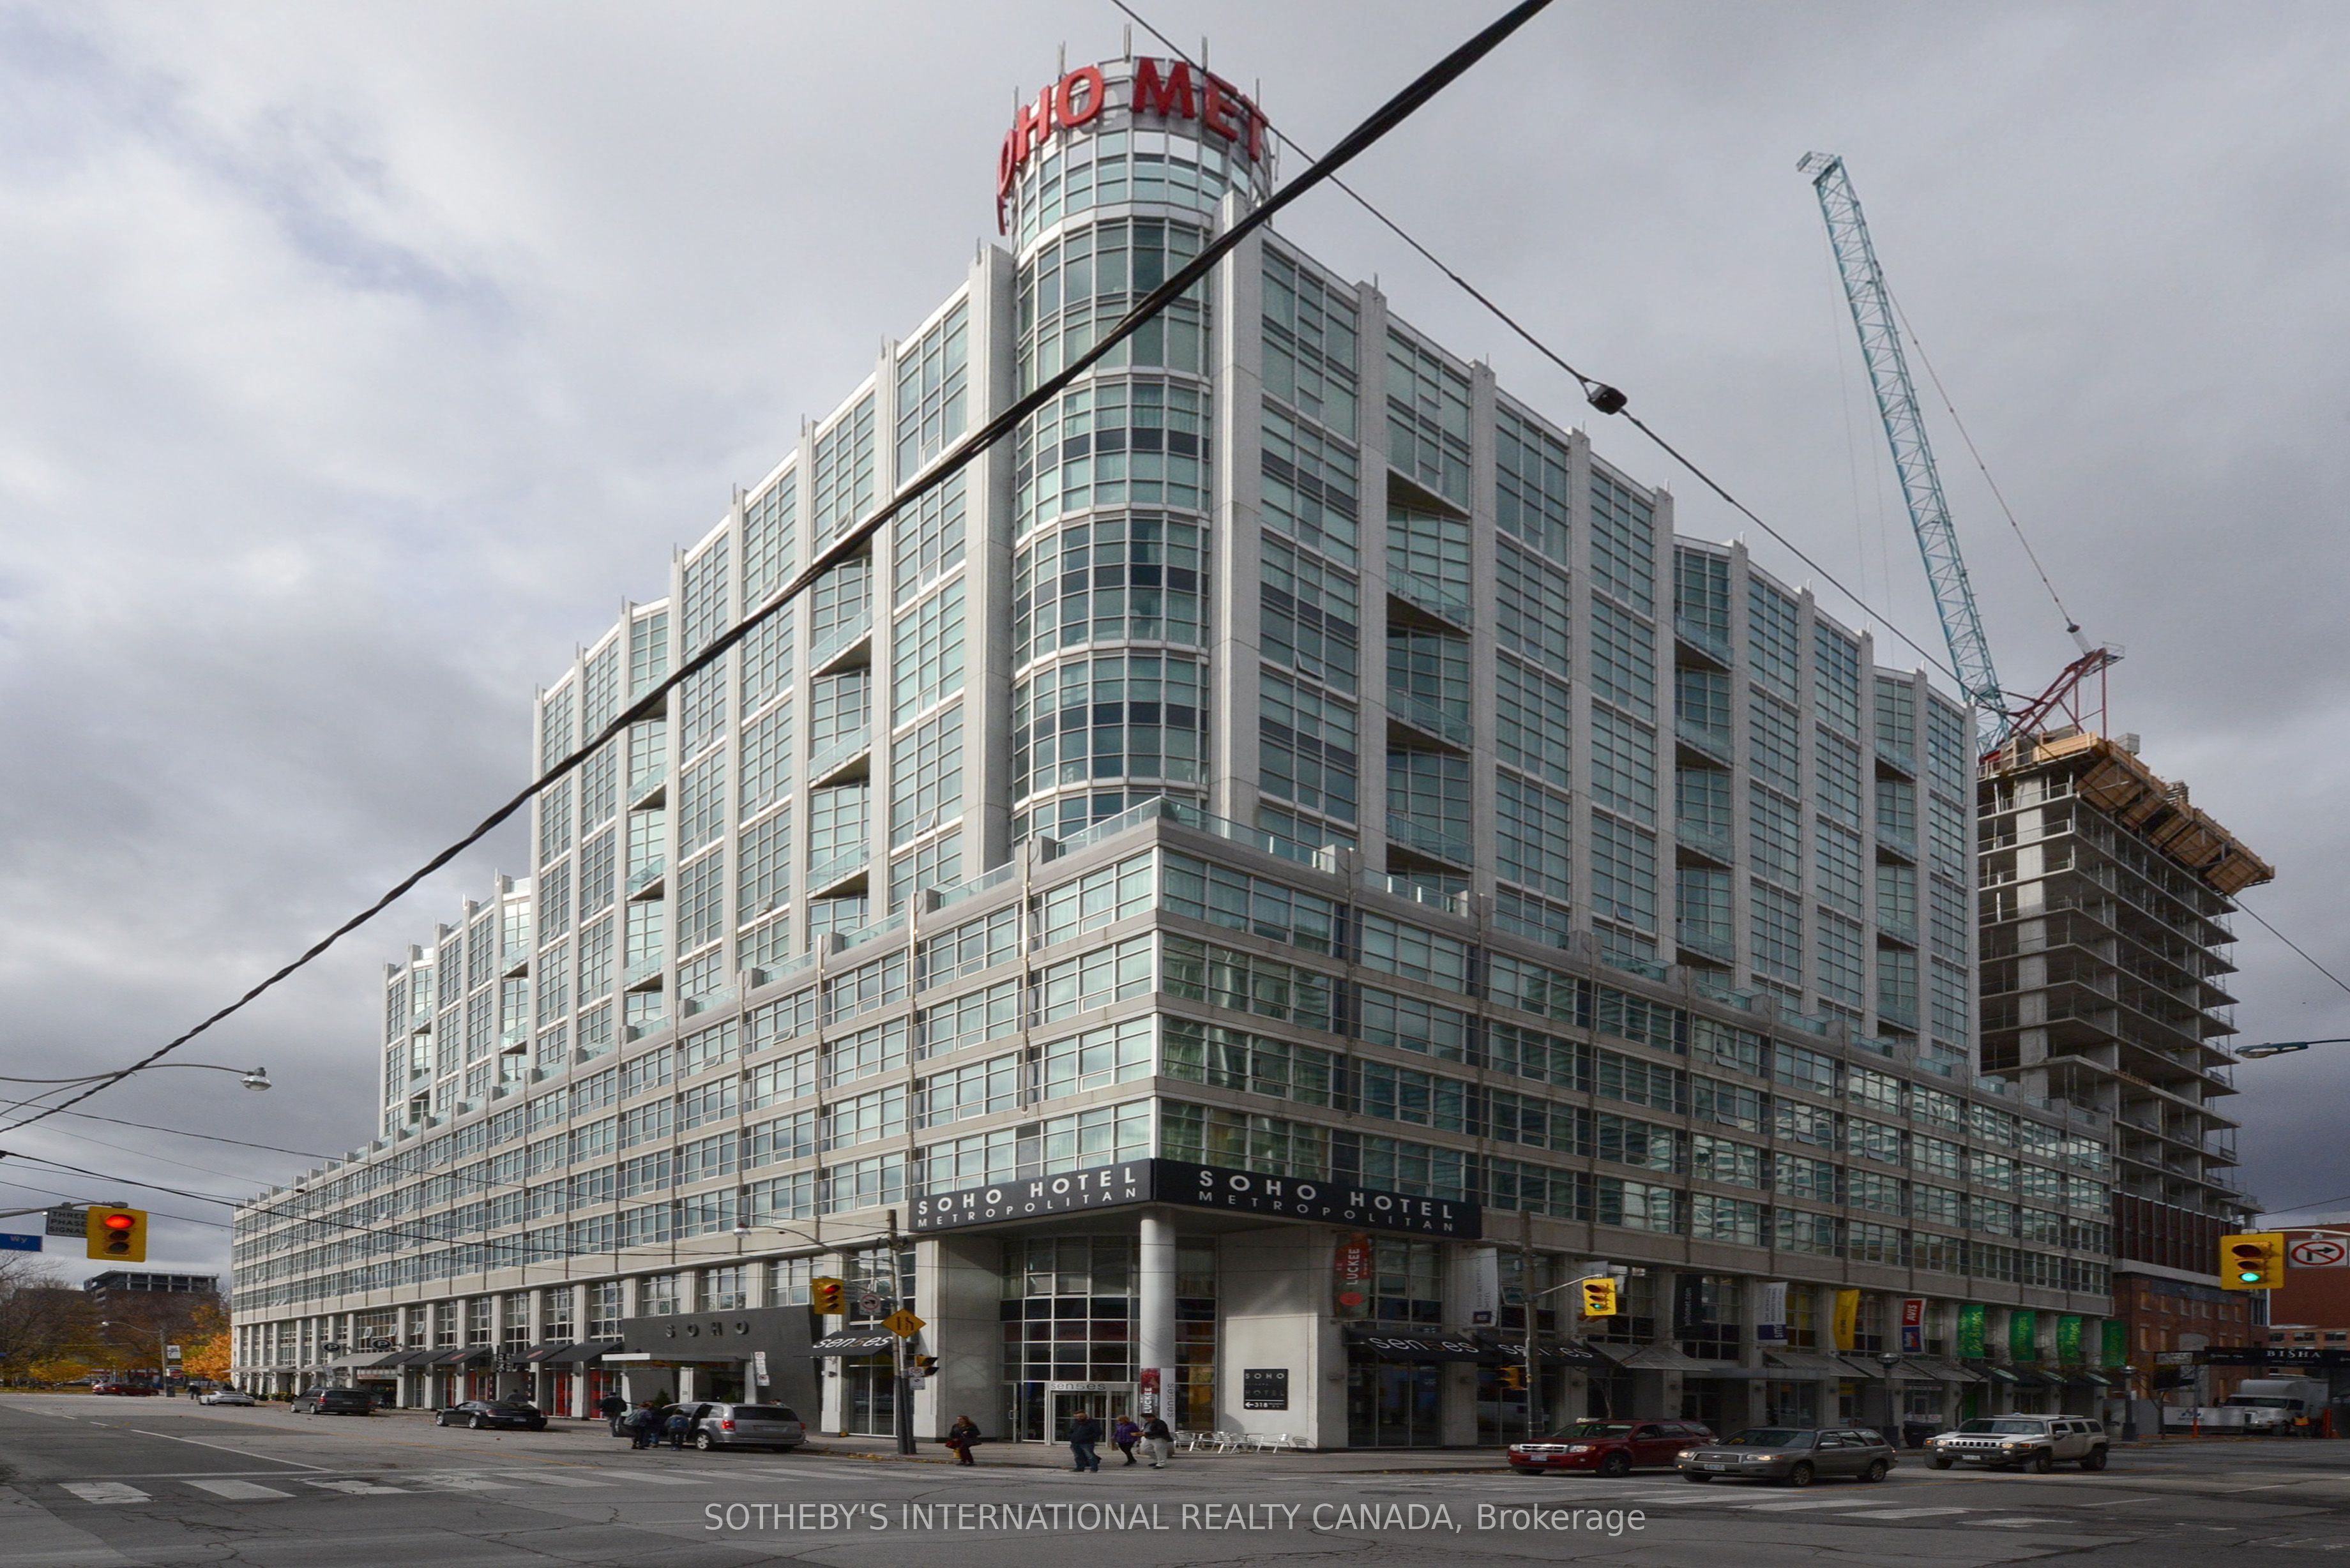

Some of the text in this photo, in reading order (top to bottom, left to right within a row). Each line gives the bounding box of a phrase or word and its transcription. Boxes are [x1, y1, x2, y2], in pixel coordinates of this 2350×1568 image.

[1132, 57, 1269, 162] MET
[918, 1168, 1135, 1215] SOHO HOTEL
[918, 1187, 1135, 1228] METROPOLITAN
[1199, 1170, 1453, 1219] SOHO HOTEL
[52, 1211, 87, 1219] THREE
[1199, 1191, 1453, 1232] METROPOLITAN
[1346, 1248, 1361, 1286] LUCKEE
[665, 1320, 750, 1338] SOHO
[1906, 1304, 1918, 1322] AVIS
[2266, 1348, 2321, 1358] BISHA
